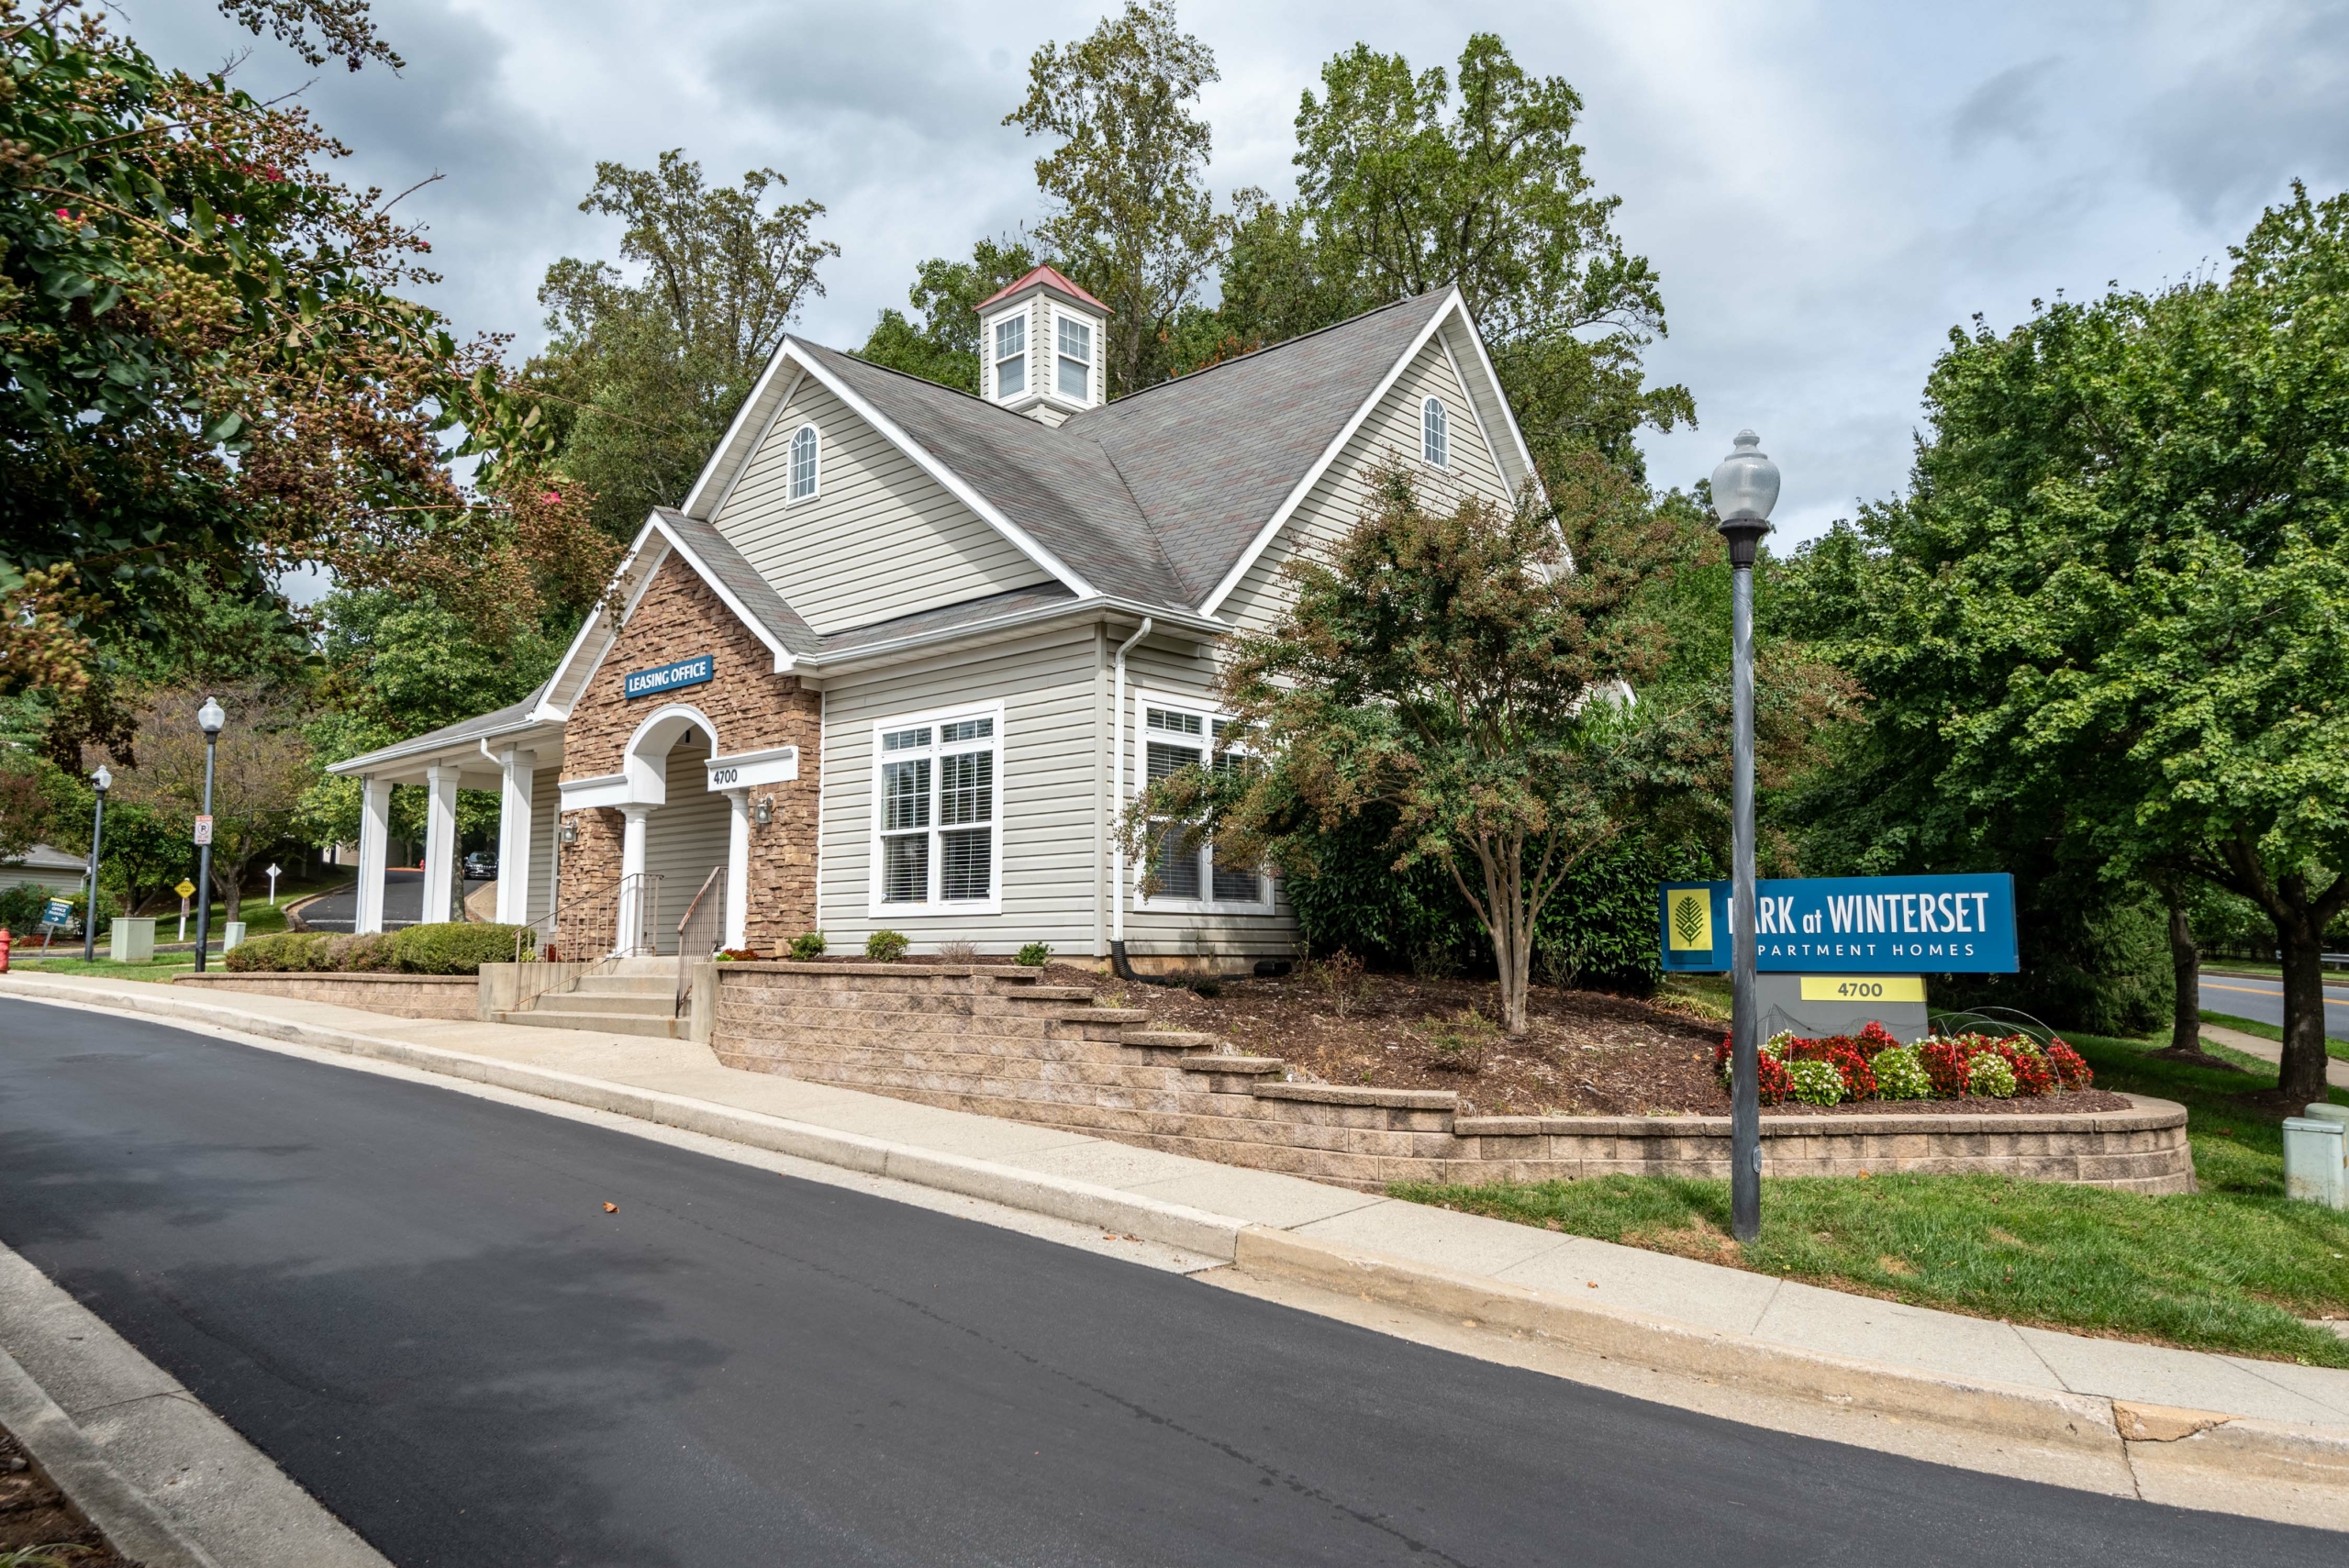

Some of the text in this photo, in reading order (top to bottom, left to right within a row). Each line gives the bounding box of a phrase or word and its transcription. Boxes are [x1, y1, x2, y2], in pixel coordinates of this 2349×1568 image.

[629, 661, 706, 693] LEASING OFFICE
[714, 768, 738, 784] 4700
[1728, 892, 1989, 934] RK at WINTERSET
[1757, 943, 1975, 956] PARTMENT HOMES
[1837, 983, 1883, 997] 4700
